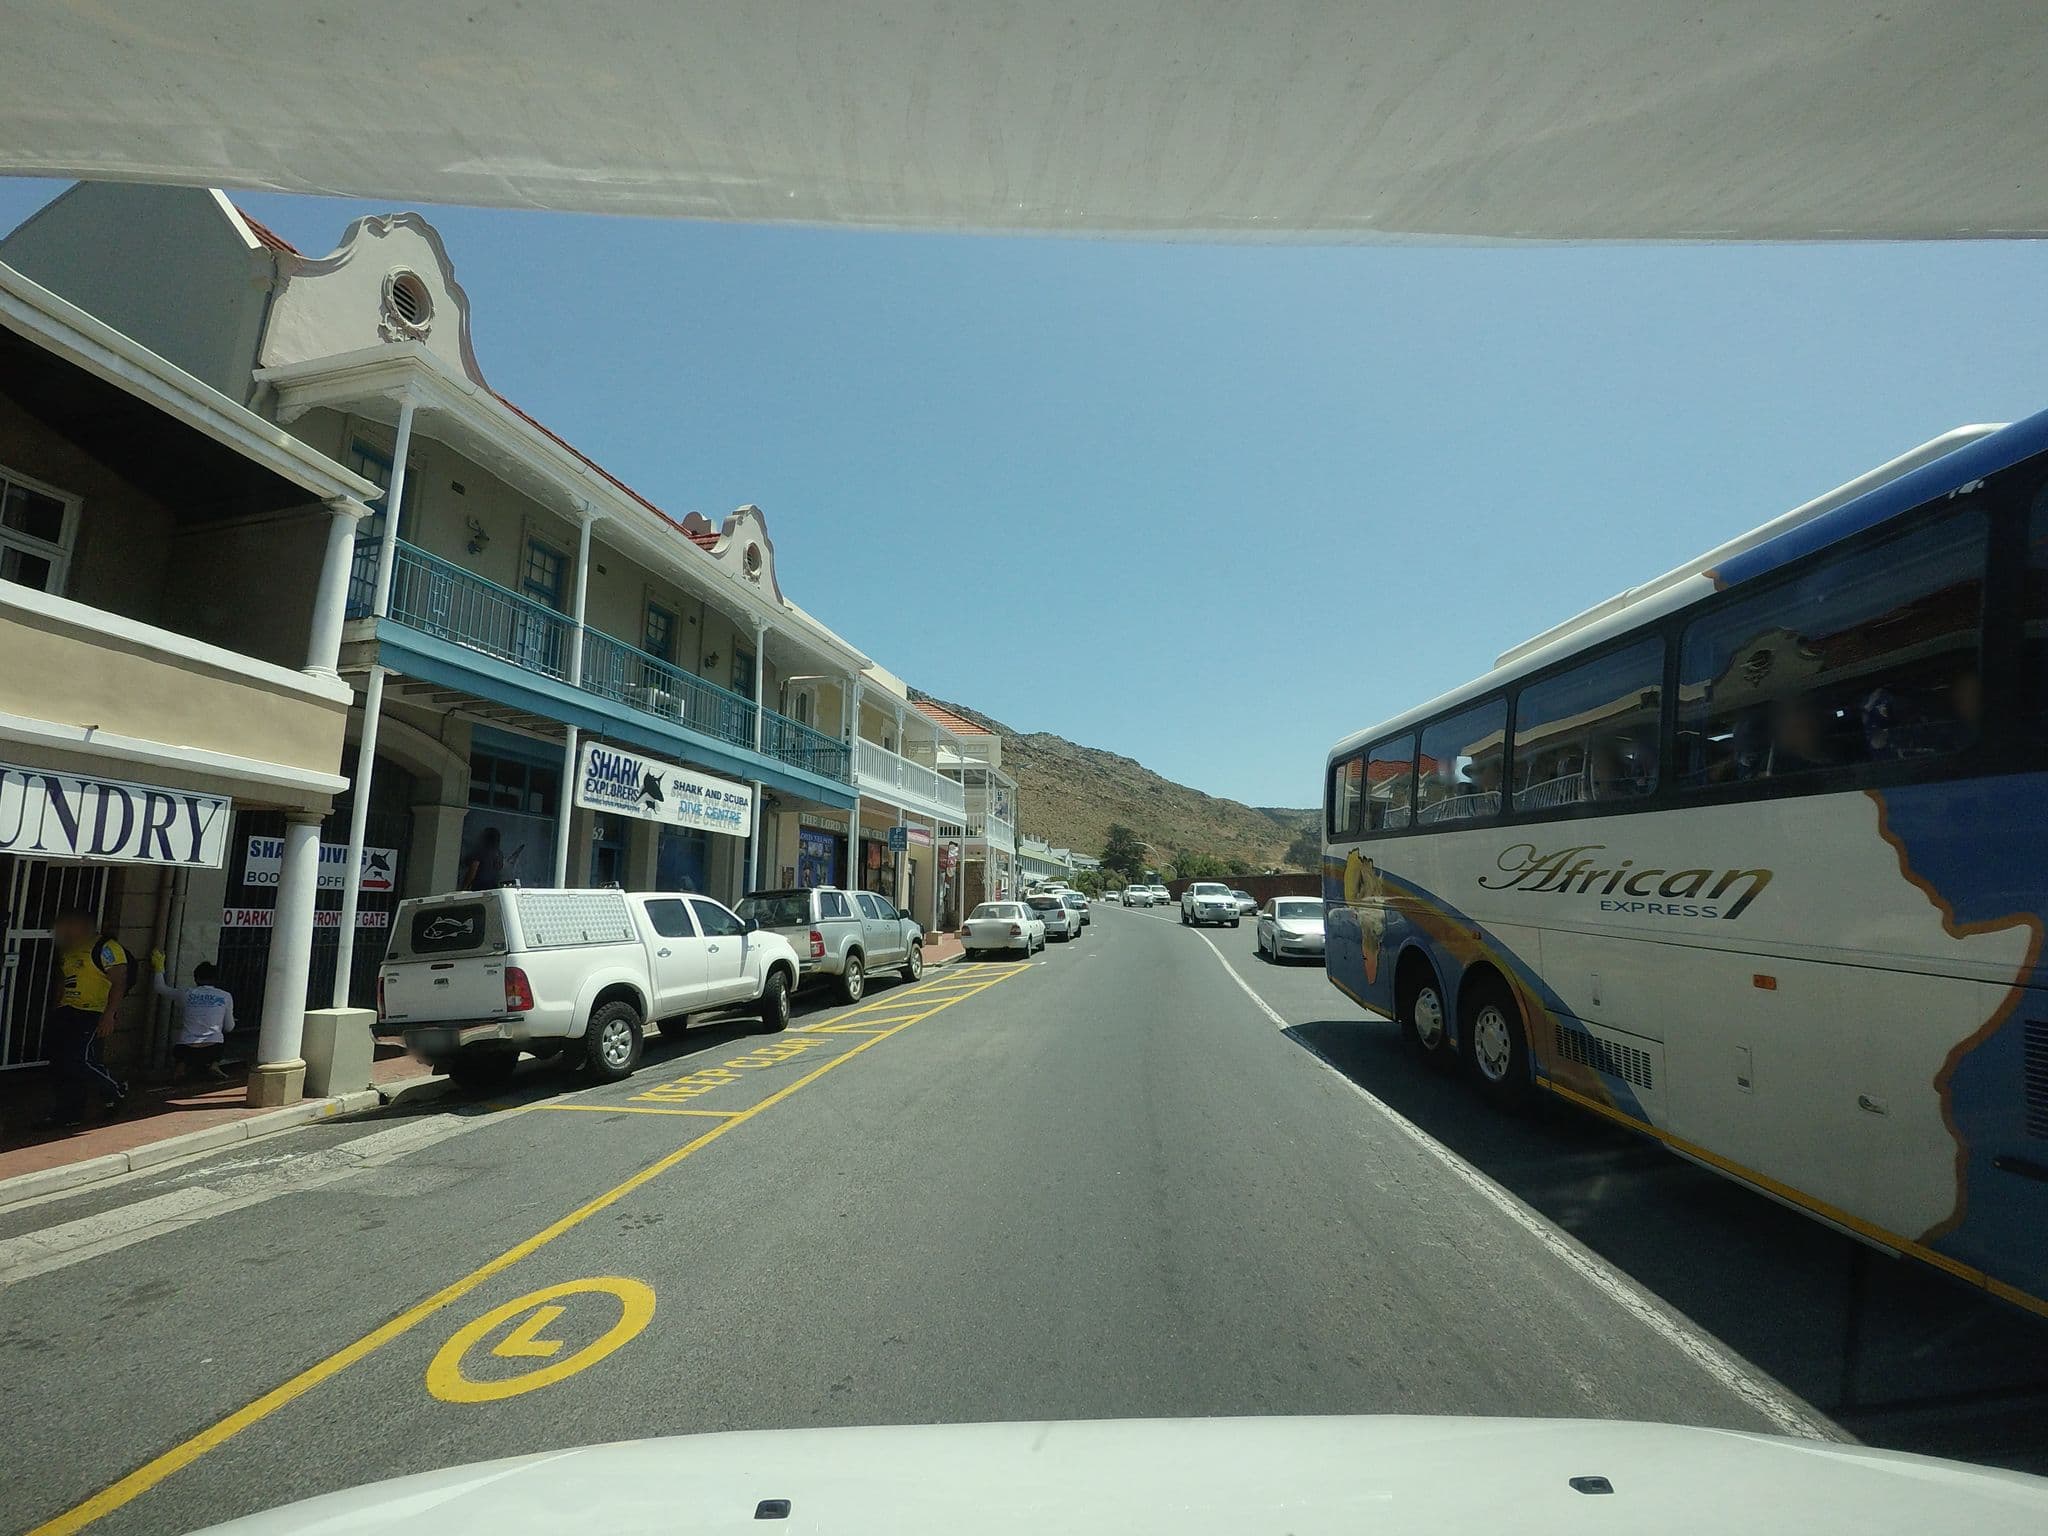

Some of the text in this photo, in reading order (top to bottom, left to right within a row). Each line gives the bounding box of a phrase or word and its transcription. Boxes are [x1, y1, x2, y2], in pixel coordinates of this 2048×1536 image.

[588, 749, 643, 788] SHARK
[585, 777, 640, 802] EXPLORERS
[673, 780, 749, 807] SHARK AND SCUBA
[680, 800, 742, 824] DIVE CENTRE
[250, 839, 367, 866] SHA DIVIG
[317, 875, 345, 888] OFFI
[1478, 843, 1774, 920] African
[236, 910, 273, 926] PARKI
[362, 913, 386, 926] GATE
[1600, 900, 1719, 919] EXPRESS
[626, 1037, 835, 1103] KEEP CLEAR
